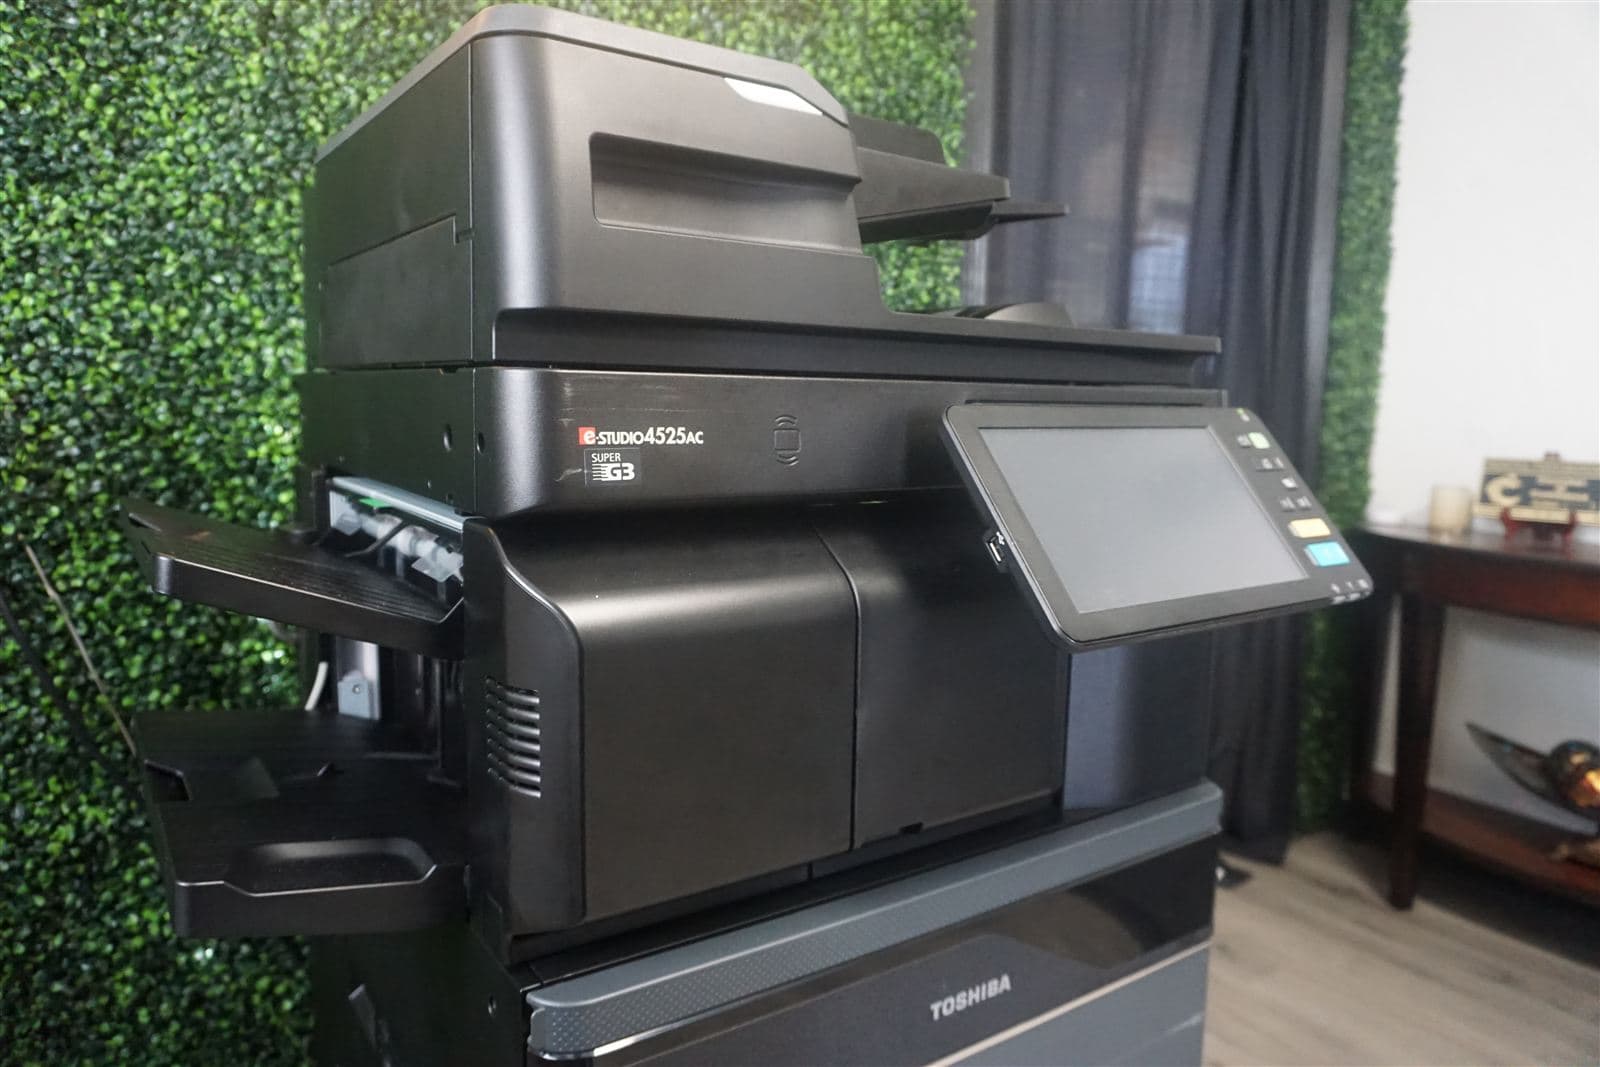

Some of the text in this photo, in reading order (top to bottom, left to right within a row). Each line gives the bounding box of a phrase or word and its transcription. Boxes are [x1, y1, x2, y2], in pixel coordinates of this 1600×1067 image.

[591, 453, 621, 462] SUPER
[596, 463, 635, 481] G3
[930, 973, 1012, 1021] TOSHIBA
